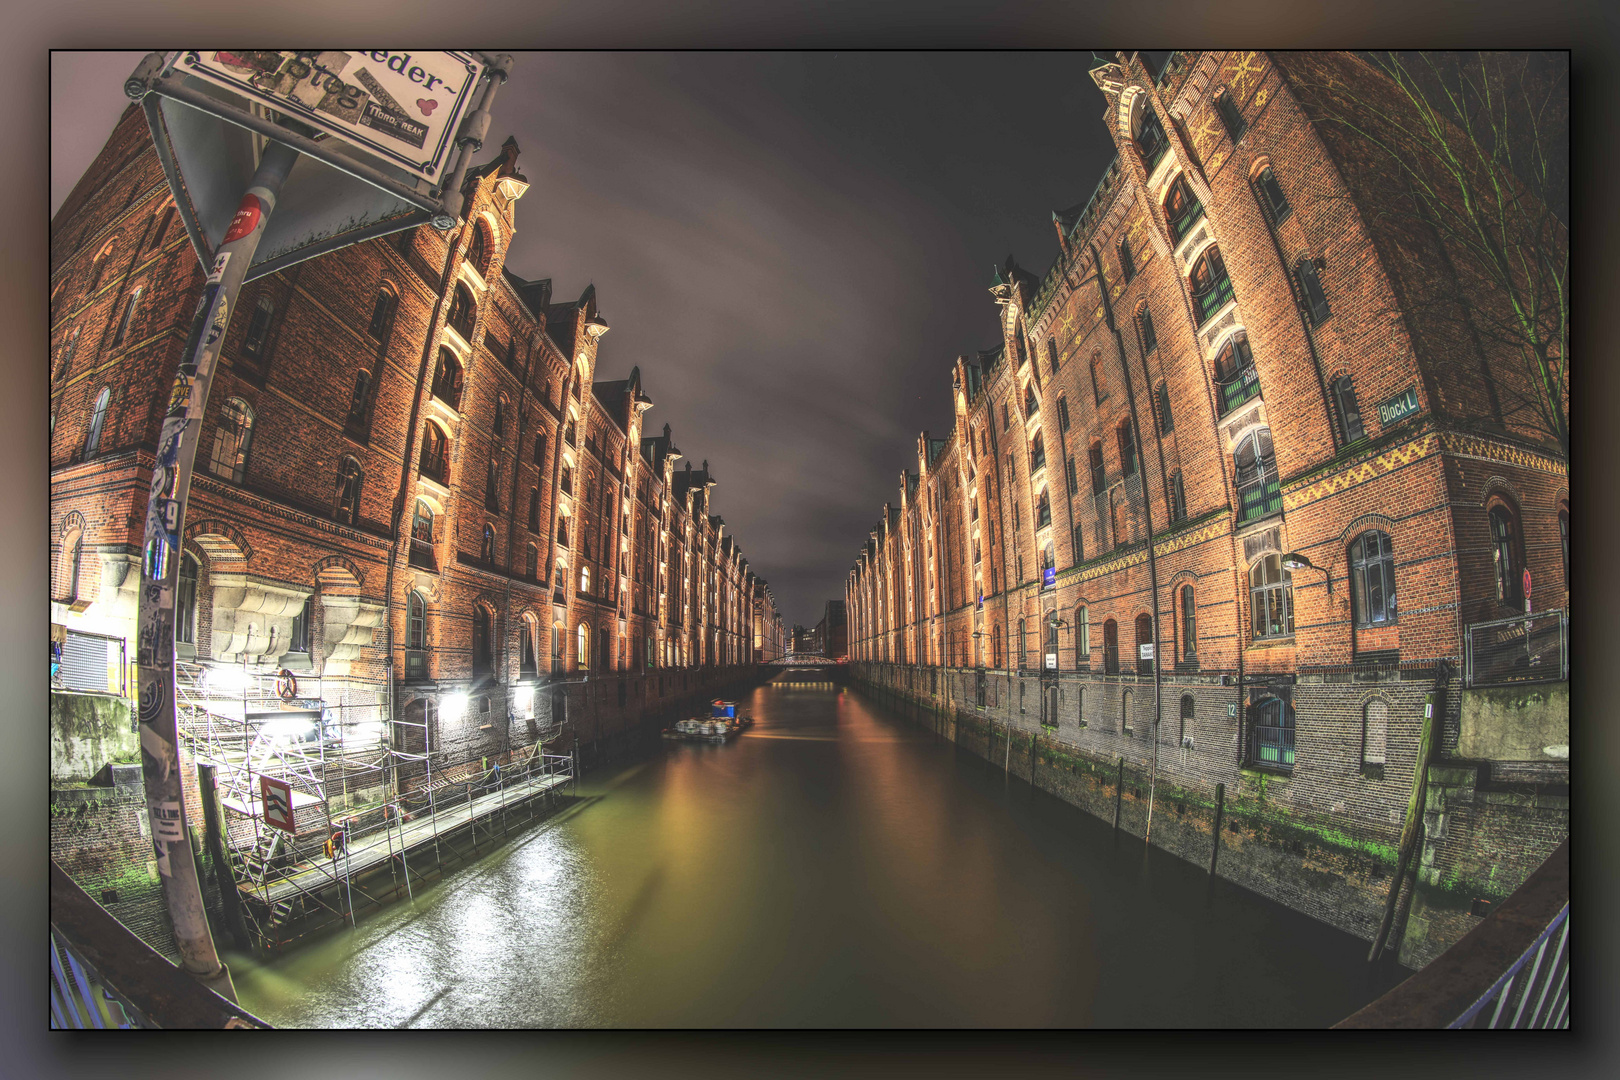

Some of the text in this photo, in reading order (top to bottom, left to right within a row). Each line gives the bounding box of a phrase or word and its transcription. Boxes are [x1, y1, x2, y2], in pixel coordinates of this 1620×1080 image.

[1381, 392, 1416, 423] Block L
[1228, 703, 1235, 716] 12
